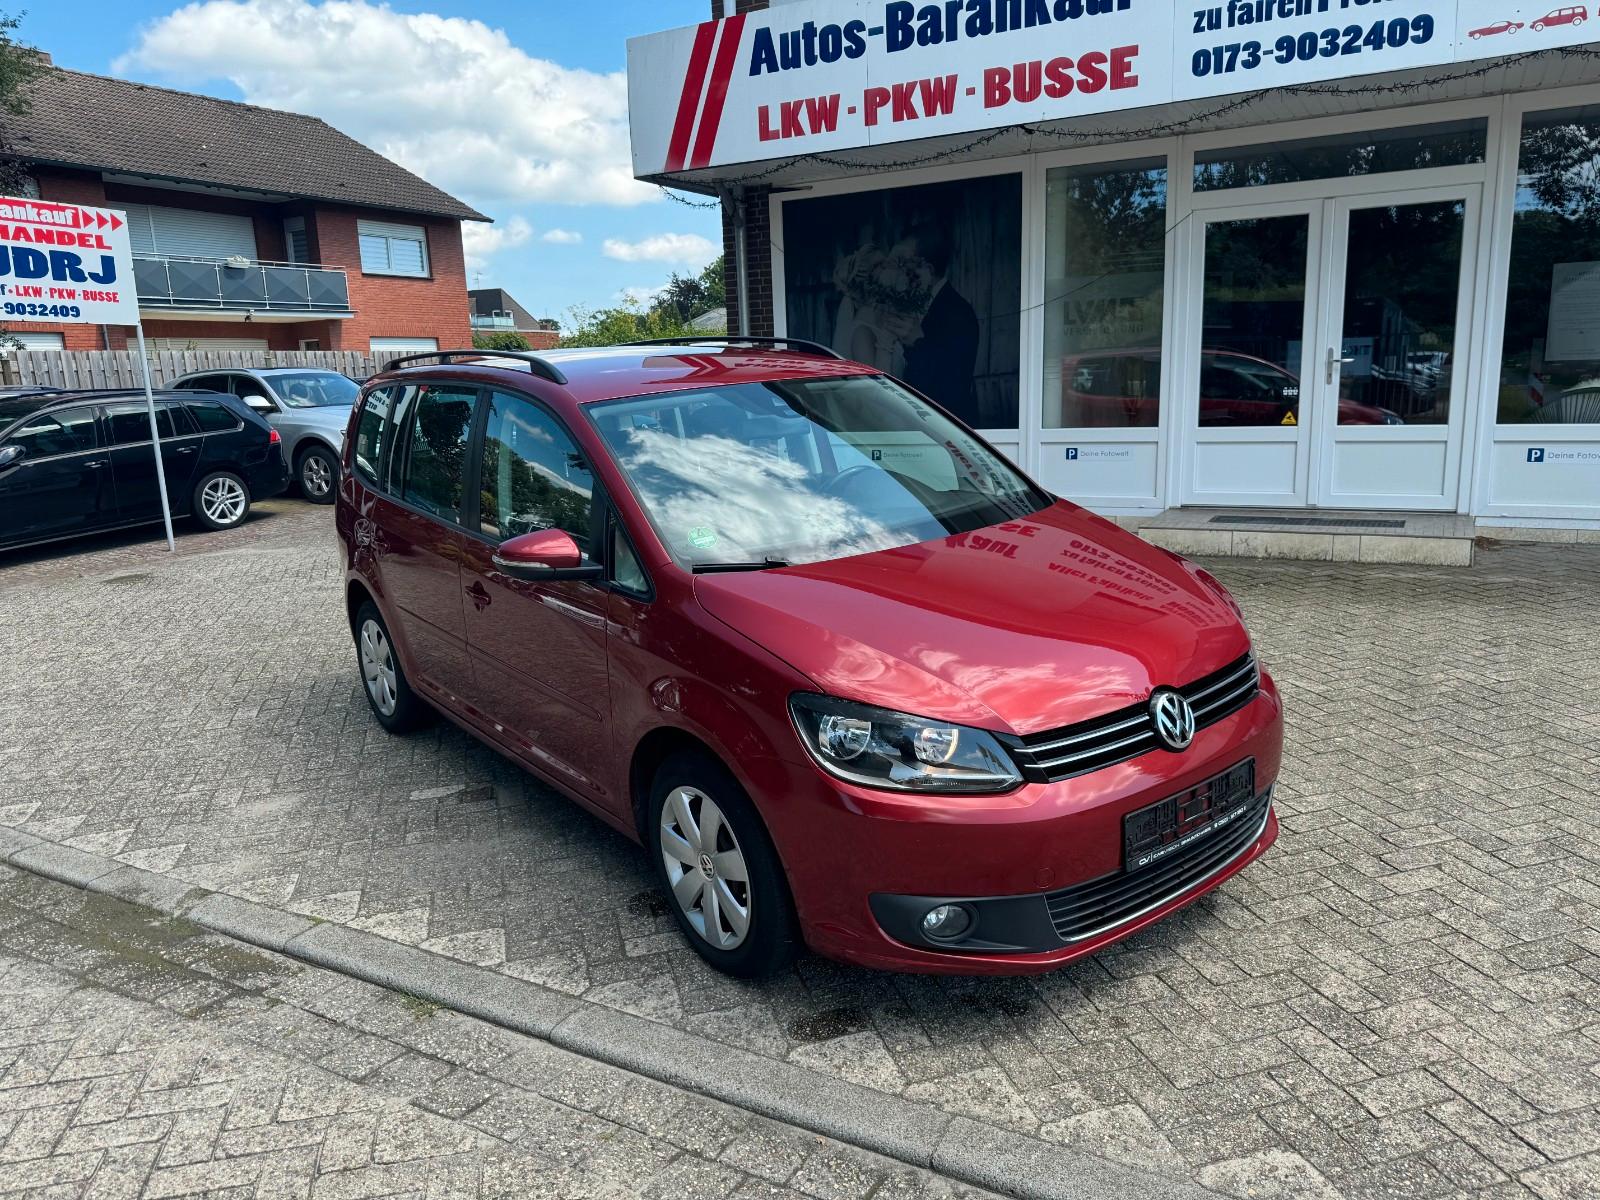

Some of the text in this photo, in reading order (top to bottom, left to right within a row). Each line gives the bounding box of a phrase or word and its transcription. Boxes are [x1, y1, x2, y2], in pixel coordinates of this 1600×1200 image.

[1193, 7, 1223, 34] zu
[1192, 14, 1434, 77] 0173-9032409
[758, 44, 1139, 142] LKW PKW BUSSE
[15, 284, 42, 298] LKW
[49, 287, 76, 300] PKW
[82, 289, 120, 303] BUSSE
[1547, 451, 1575, 460] Deine
